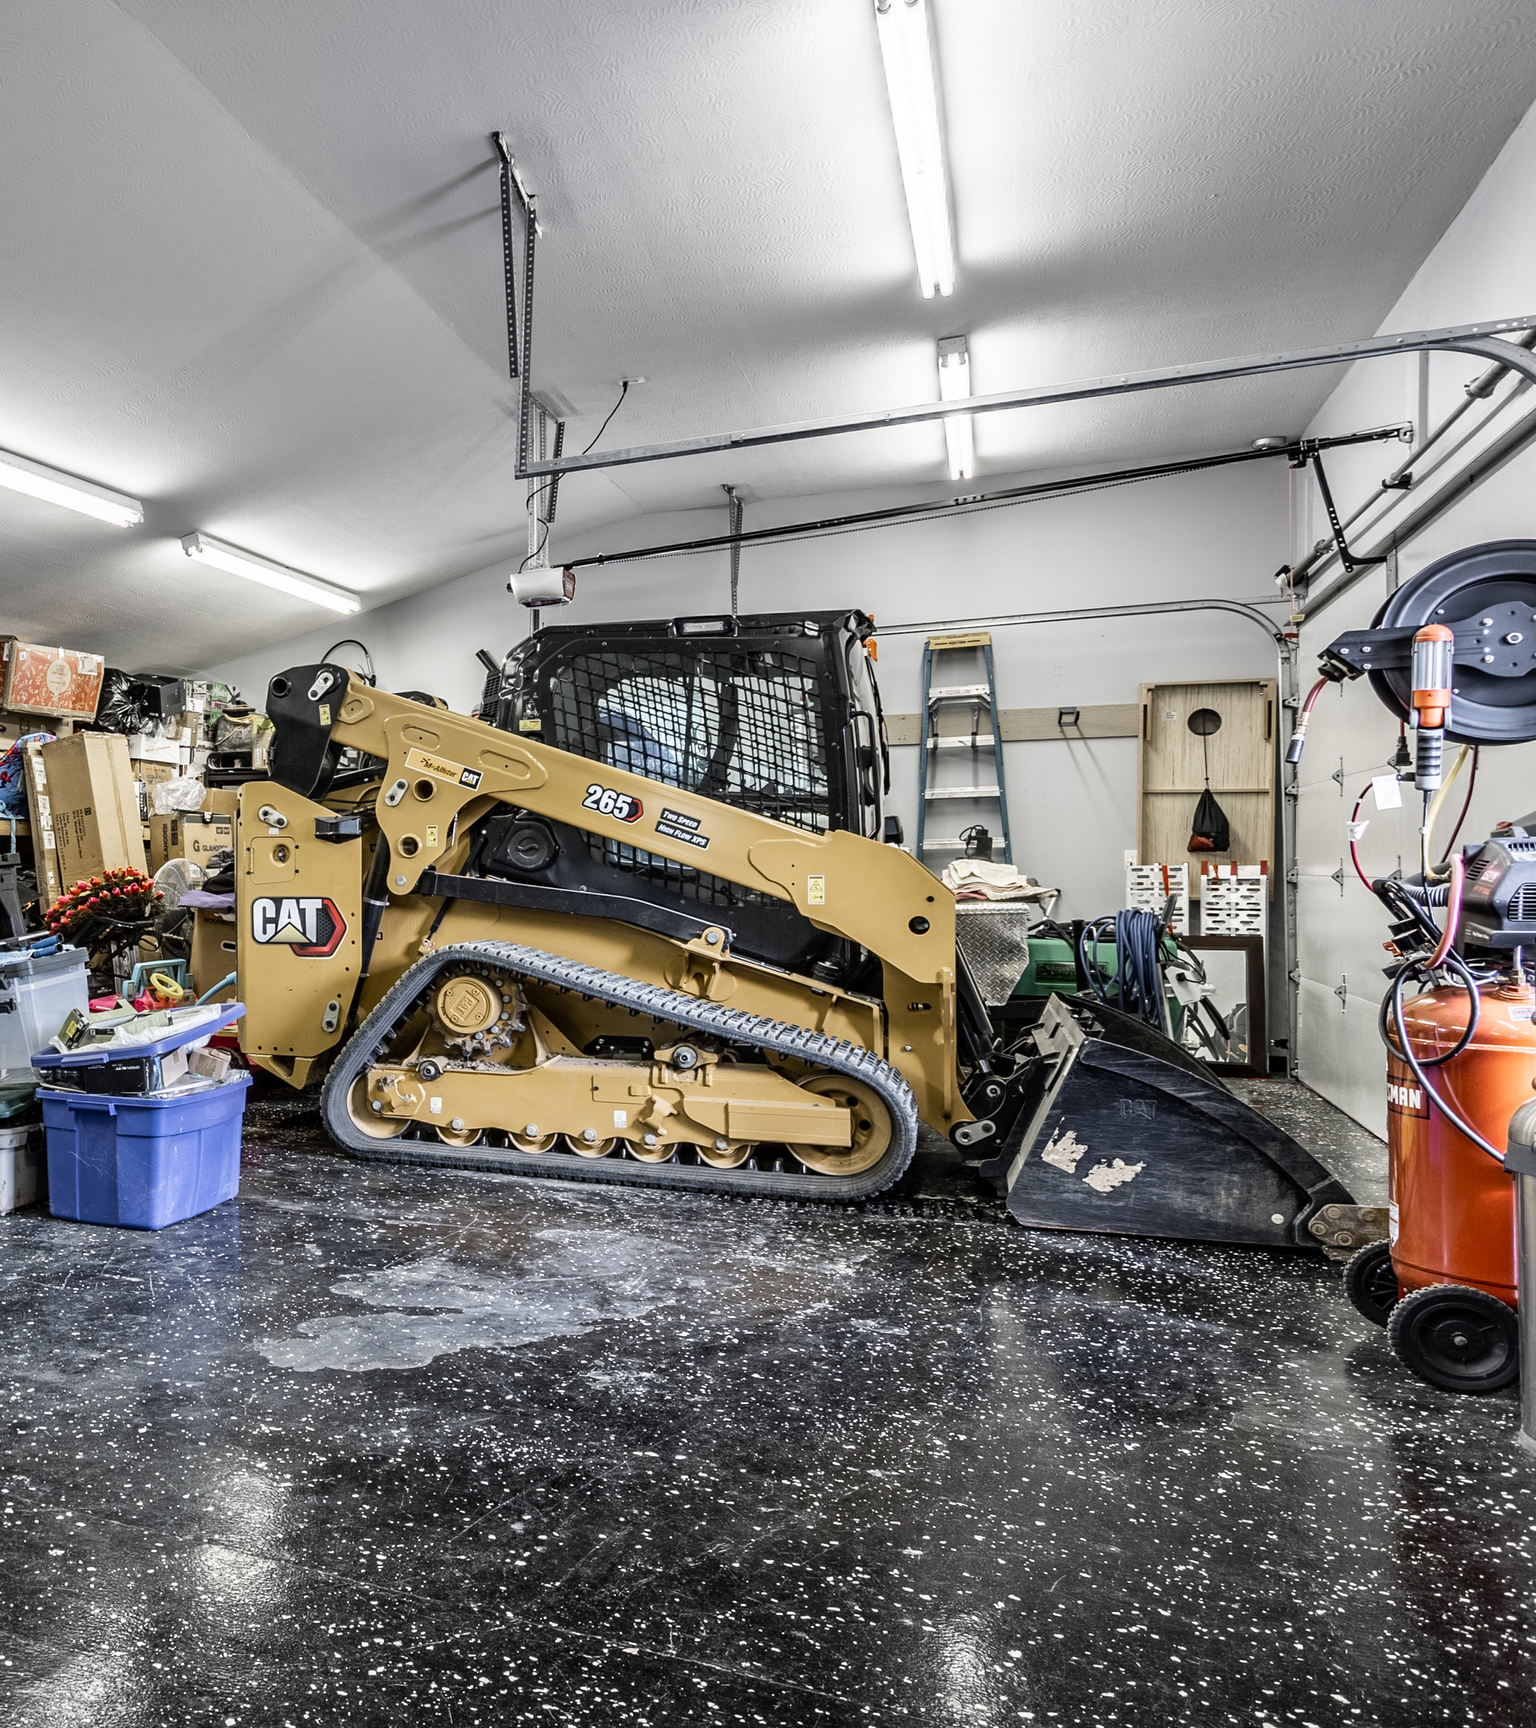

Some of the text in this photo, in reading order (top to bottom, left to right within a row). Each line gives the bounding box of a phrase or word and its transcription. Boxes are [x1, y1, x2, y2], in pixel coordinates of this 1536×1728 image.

[461, 771, 480, 786] CAT
[582, 784, 633, 819] 265
[692, 836, 708, 846] XPS
[253, 898, 322, 943] CAT
